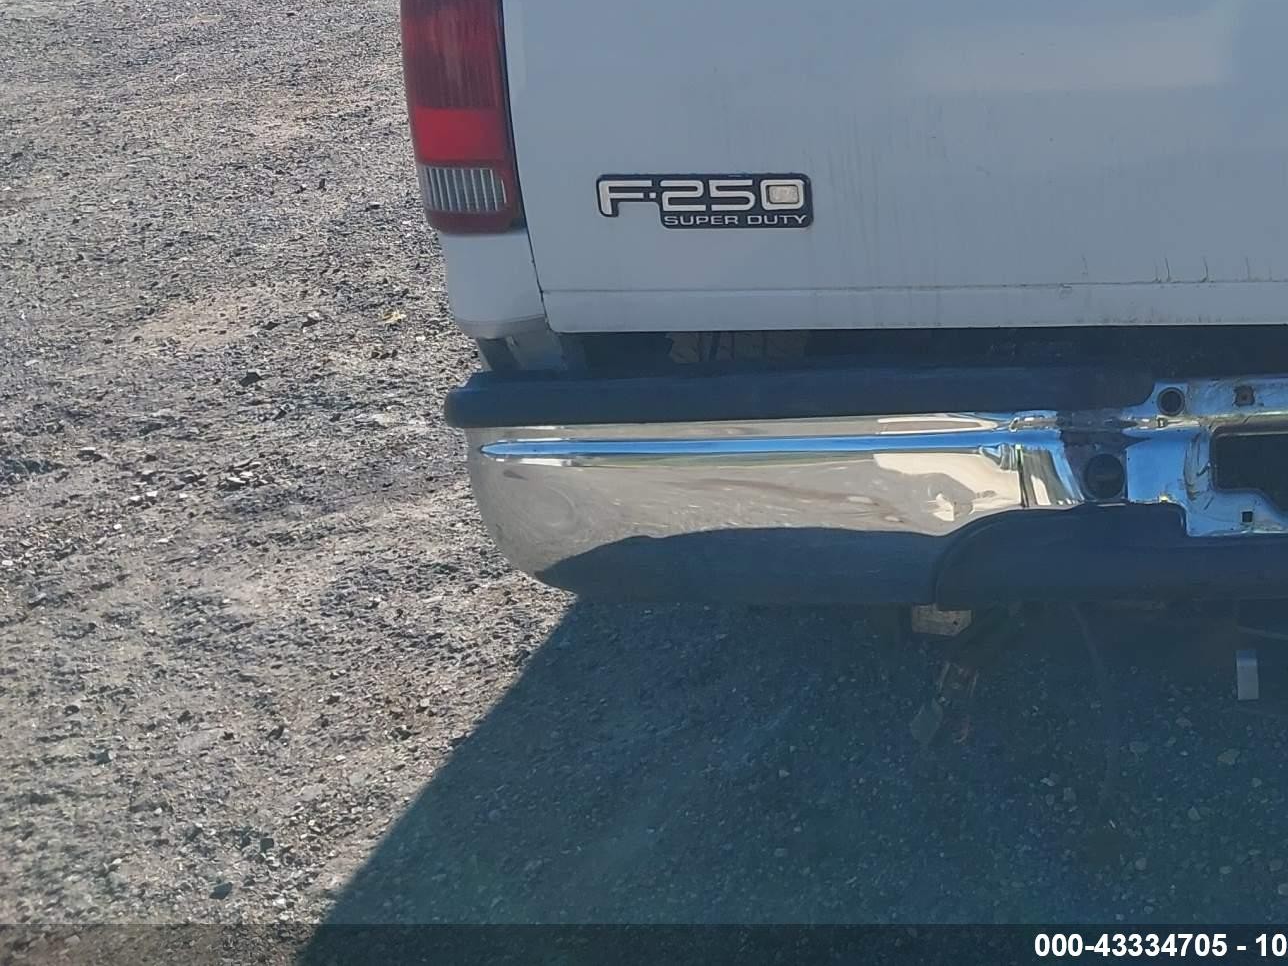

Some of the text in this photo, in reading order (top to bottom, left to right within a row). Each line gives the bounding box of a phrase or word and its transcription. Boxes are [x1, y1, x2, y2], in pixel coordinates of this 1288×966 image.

[599, 179, 805, 215] F-250
[663, 214, 807, 226] SUPER DUTY
